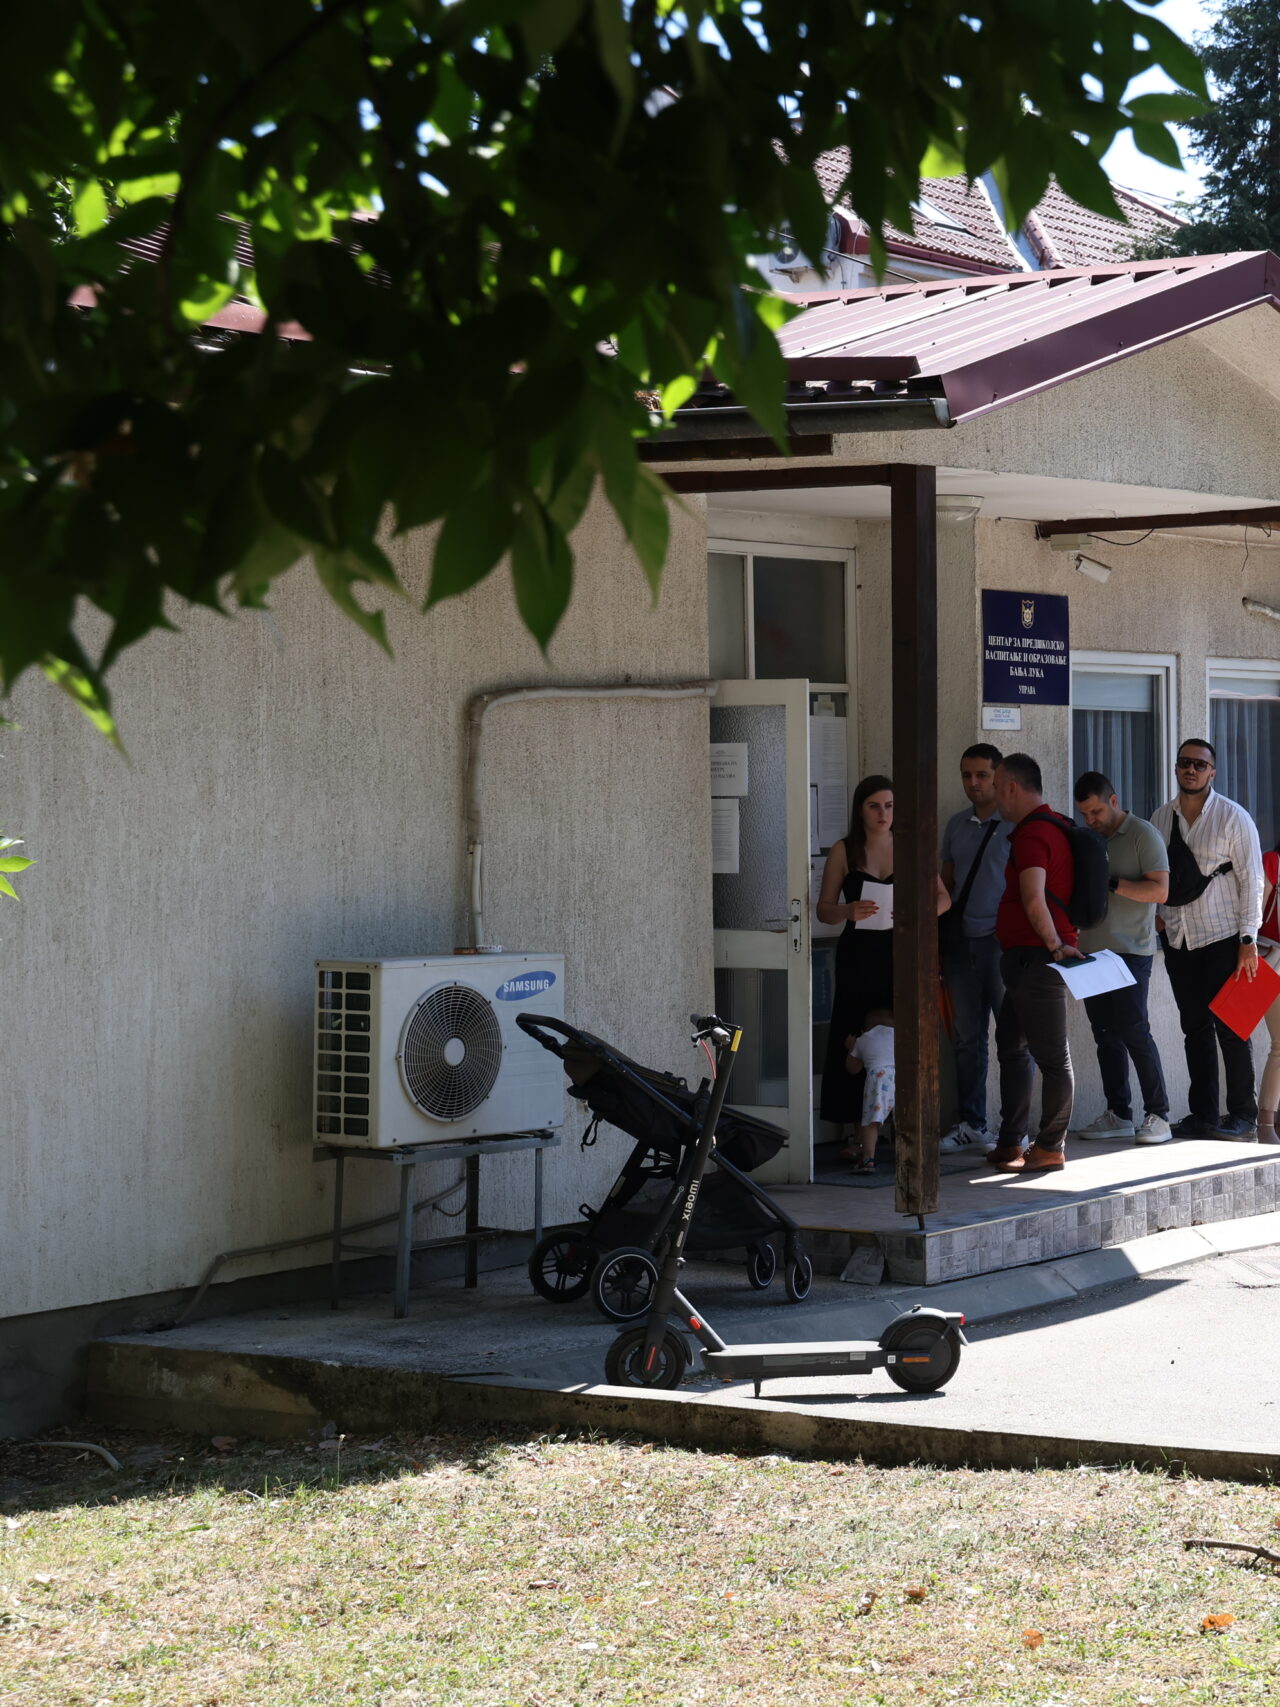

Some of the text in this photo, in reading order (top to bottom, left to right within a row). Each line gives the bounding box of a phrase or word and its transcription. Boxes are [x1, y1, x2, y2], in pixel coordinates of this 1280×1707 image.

[988, 635, 1065, 651] ЦЕНТАР ЗА ПРЕДШКОЛСКО
[985, 650, 1067, 665] ВАСПИТАЊЕ И ОБРАЗОВАЊЕ
[1010, 666, 1044, 678] БАЊА ЛУКА
[1019, 685, 1036, 695] УПРАВА
[503, 979, 550, 993] SAMSUNG
[681, 1179, 700, 1221] xiaomi
